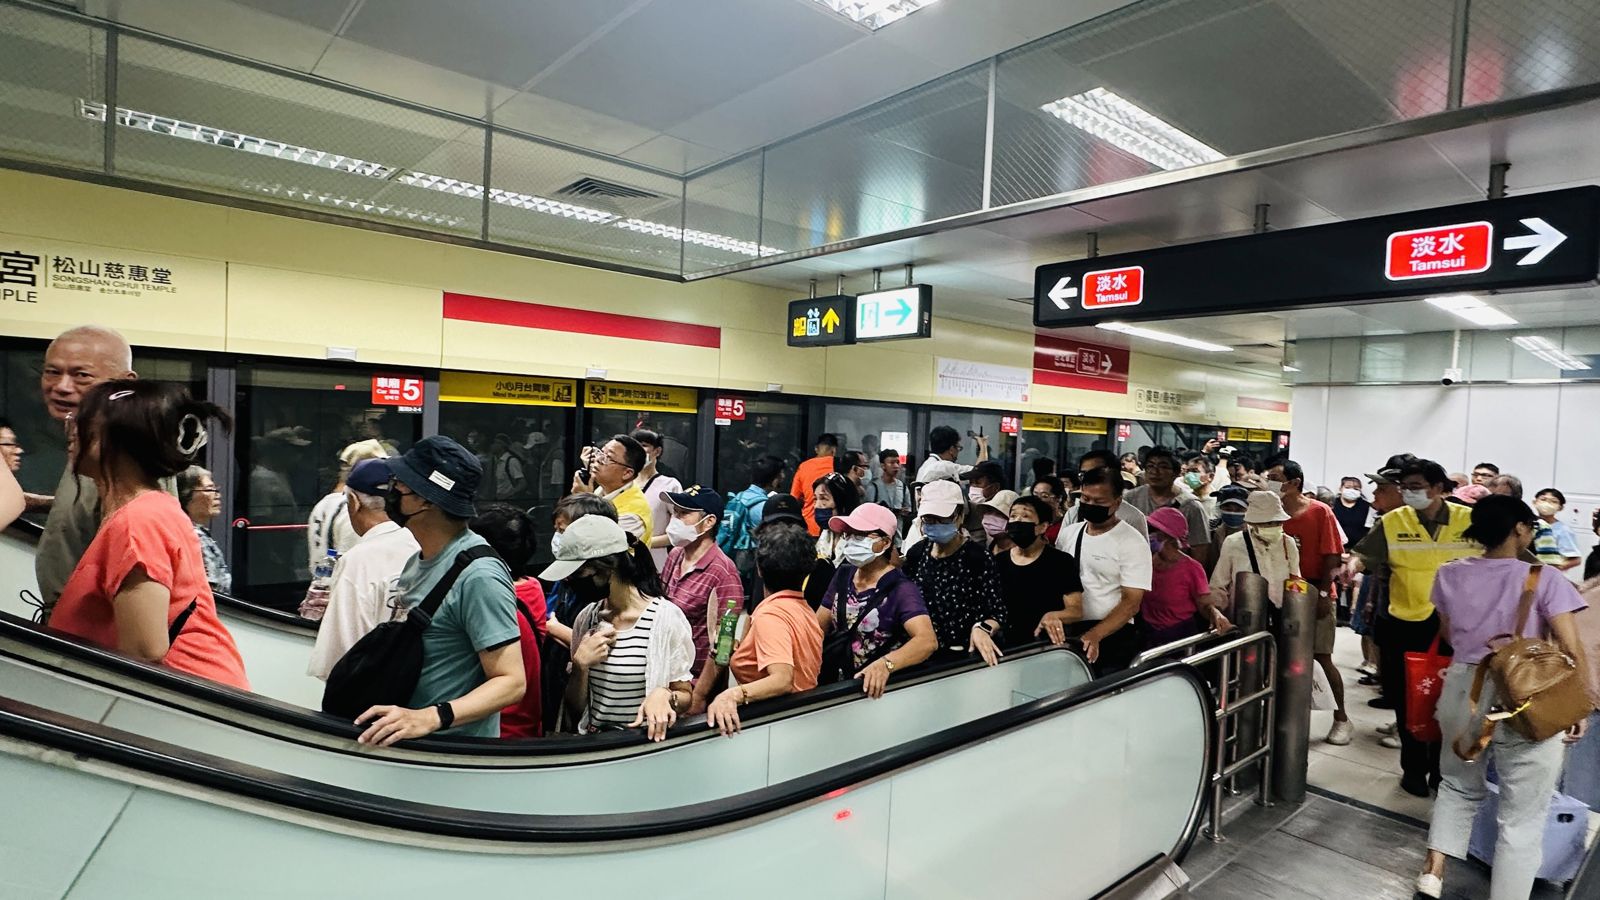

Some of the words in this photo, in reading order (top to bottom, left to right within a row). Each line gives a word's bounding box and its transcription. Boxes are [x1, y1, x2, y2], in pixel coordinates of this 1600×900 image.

[1410, 232, 1465, 257] 淡水
[52, 255, 172, 285] 松山慈惠堂
[1408, 255, 1466, 272] Tamsui
[52, 274, 110, 286] SONGSHAN
[112, 280, 139, 289] CIHUI
[141, 284, 176, 293] TEMPLE
[1096, 274, 1127, 292] 淡水
[0, 289, 38, 303] PLE
[1095, 291, 1128, 303] Tamsui
[402, 379, 420, 401] 5
[733, 400, 744, 416] 5
